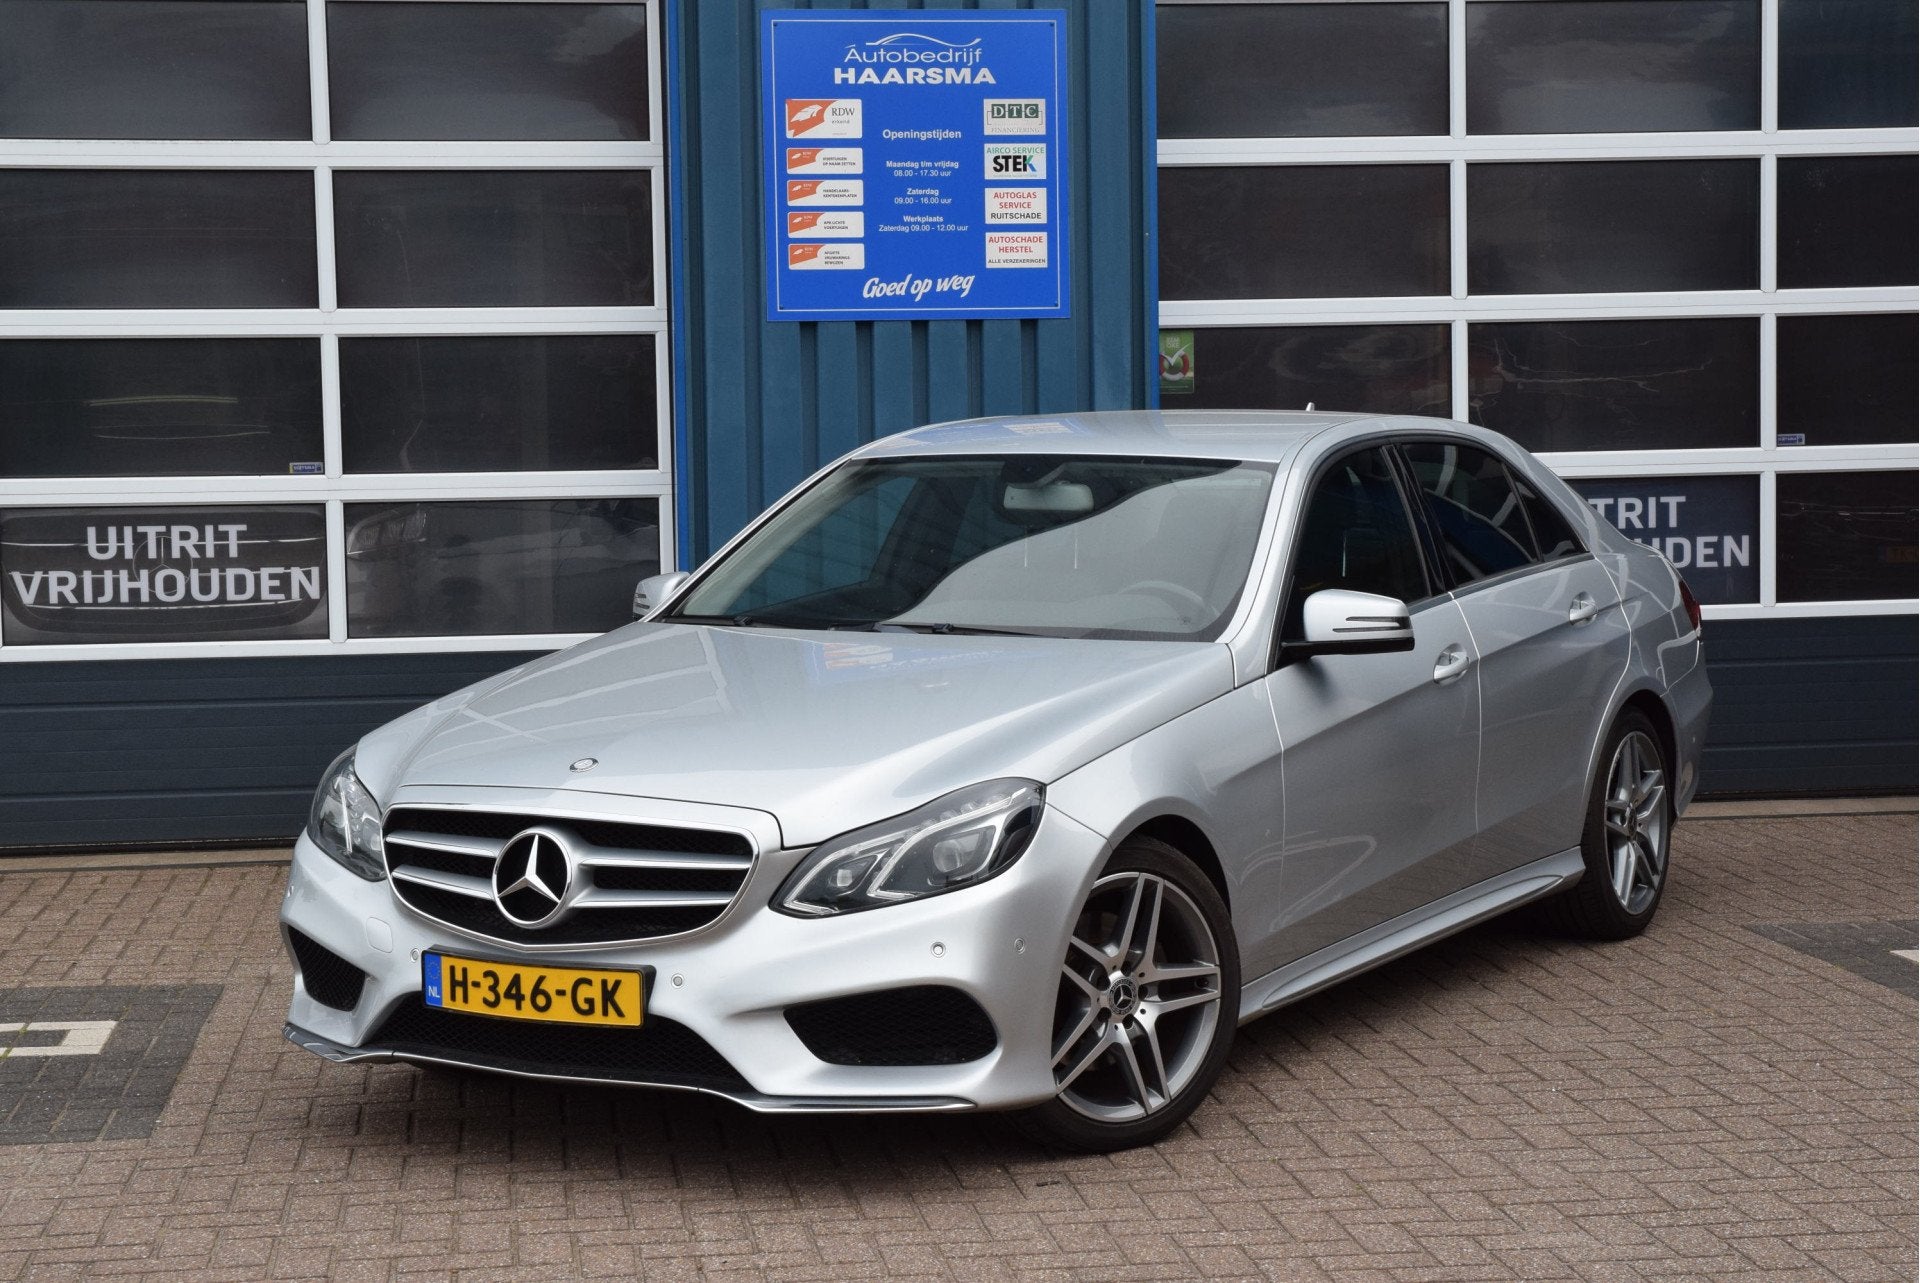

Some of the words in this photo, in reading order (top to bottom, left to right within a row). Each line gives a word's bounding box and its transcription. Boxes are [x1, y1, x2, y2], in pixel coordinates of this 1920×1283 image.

[844, 47, 982, 66] Autobedrijf
[834, 67, 997, 84] HAARSMA
[832, 107, 855, 116] RDW
[992, 105, 1038, 118] DTC
[882, 129, 962, 140] Openingstijden
[886, 160, 919, 168] Maandag
[934, 160, 959, 168] vrijdag
[992, 154, 1037, 172] STEK
[907, 188, 939, 196] Zaterdag
[903, 215, 944, 223] Werkplaats
[878, 224, 909, 232] Zaterdag
[862, 273, 913, 298] Goed
[910, 278, 933, 302] op
[936, 274, 976, 298] weg
[1588, 496, 1686, 530] TRIT
[86, 524, 248, 560] UITRIT
[12, 566, 320, 605] VRIJHOUDEN
[428, 986, 440, 999] NL
[449, 965, 626, 1018] H-346-GK
